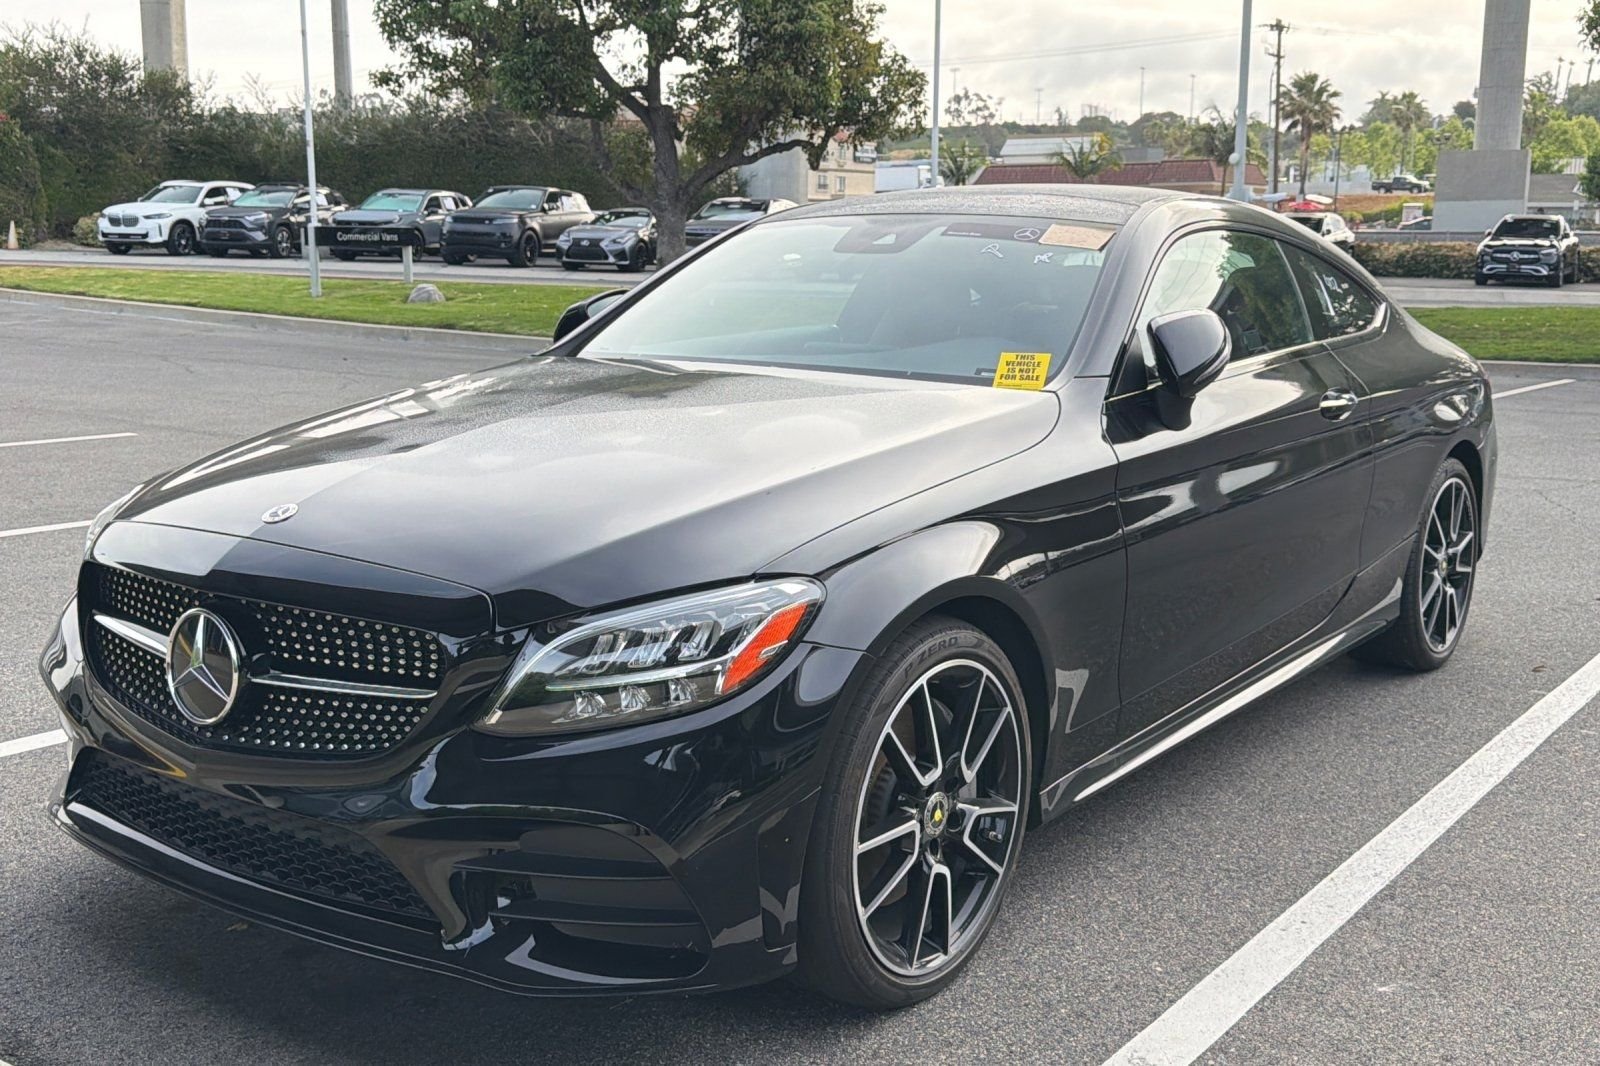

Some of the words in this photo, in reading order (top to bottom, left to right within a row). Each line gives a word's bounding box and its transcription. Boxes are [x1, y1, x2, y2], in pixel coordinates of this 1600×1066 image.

[336, 231, 380, 241] Commercial
[381, 232, 398, 242] Vans
[1005, 360, 1042, 368] VEHICLE
[999, 373, 1017, 381] FOR
[1018, 374, 1041, 382] SALE
[904, 663, 913, 678] P
[917, 636, 958, 663] ZERO
